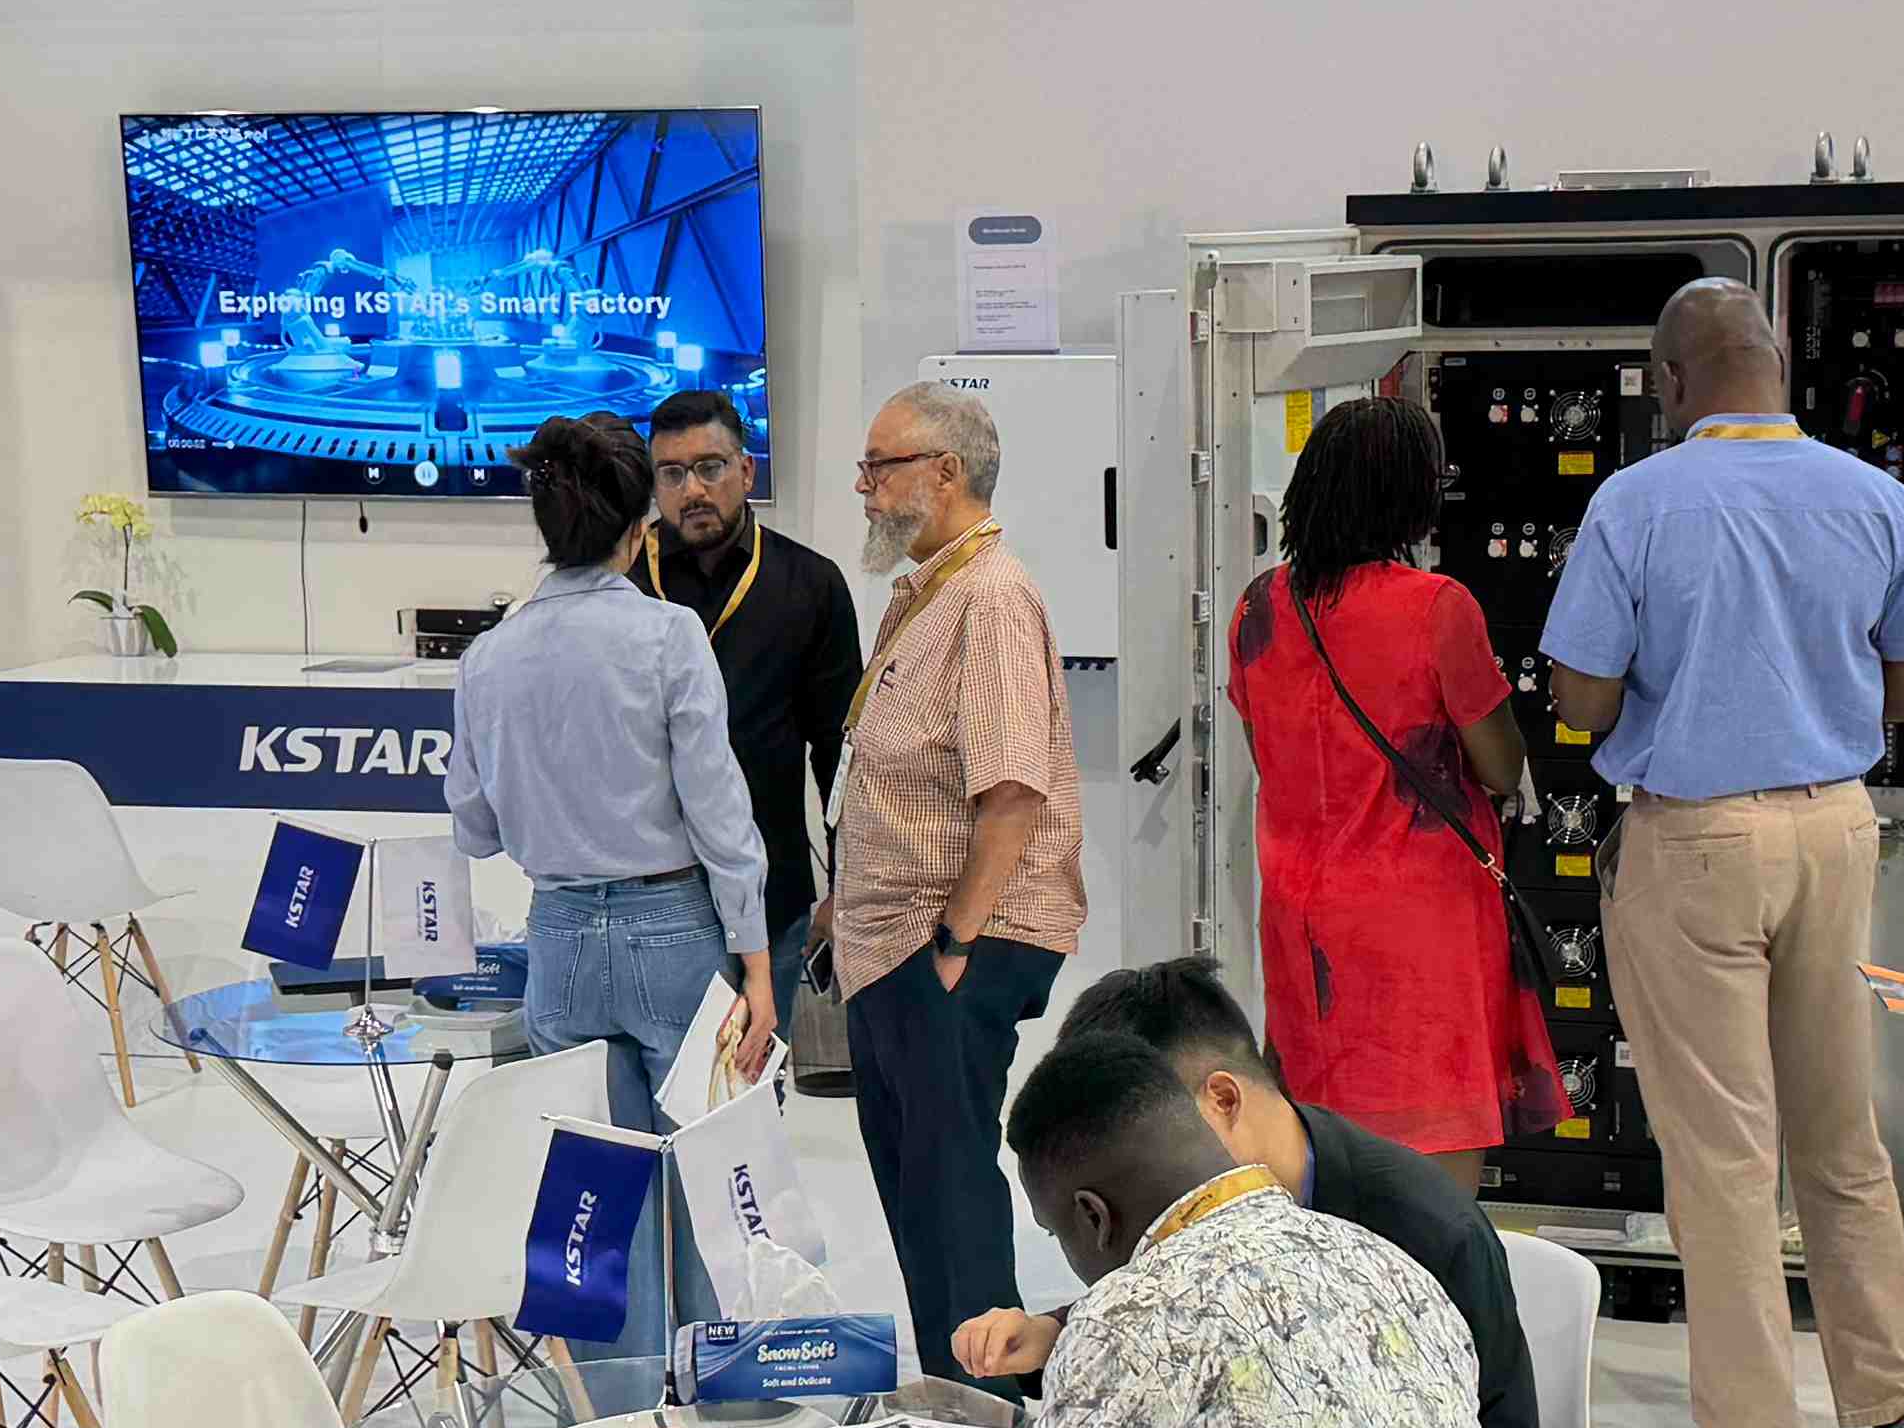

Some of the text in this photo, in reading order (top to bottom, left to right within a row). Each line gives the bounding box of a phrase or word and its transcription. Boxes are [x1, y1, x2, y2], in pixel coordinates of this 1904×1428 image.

[219, 290, 672, 320] Exploring KSTAR's Smart Factory
[239, 726, 453, 775] KSTAR
[285, 866, 314, 929] KSTAR
[422, 881, 439, 943] KSTAR
[566, 1191, 598, 1287] KSTAR
[708, 1325, 736, 1336] NEW
[762, 1377, 780, 1388] Soft
